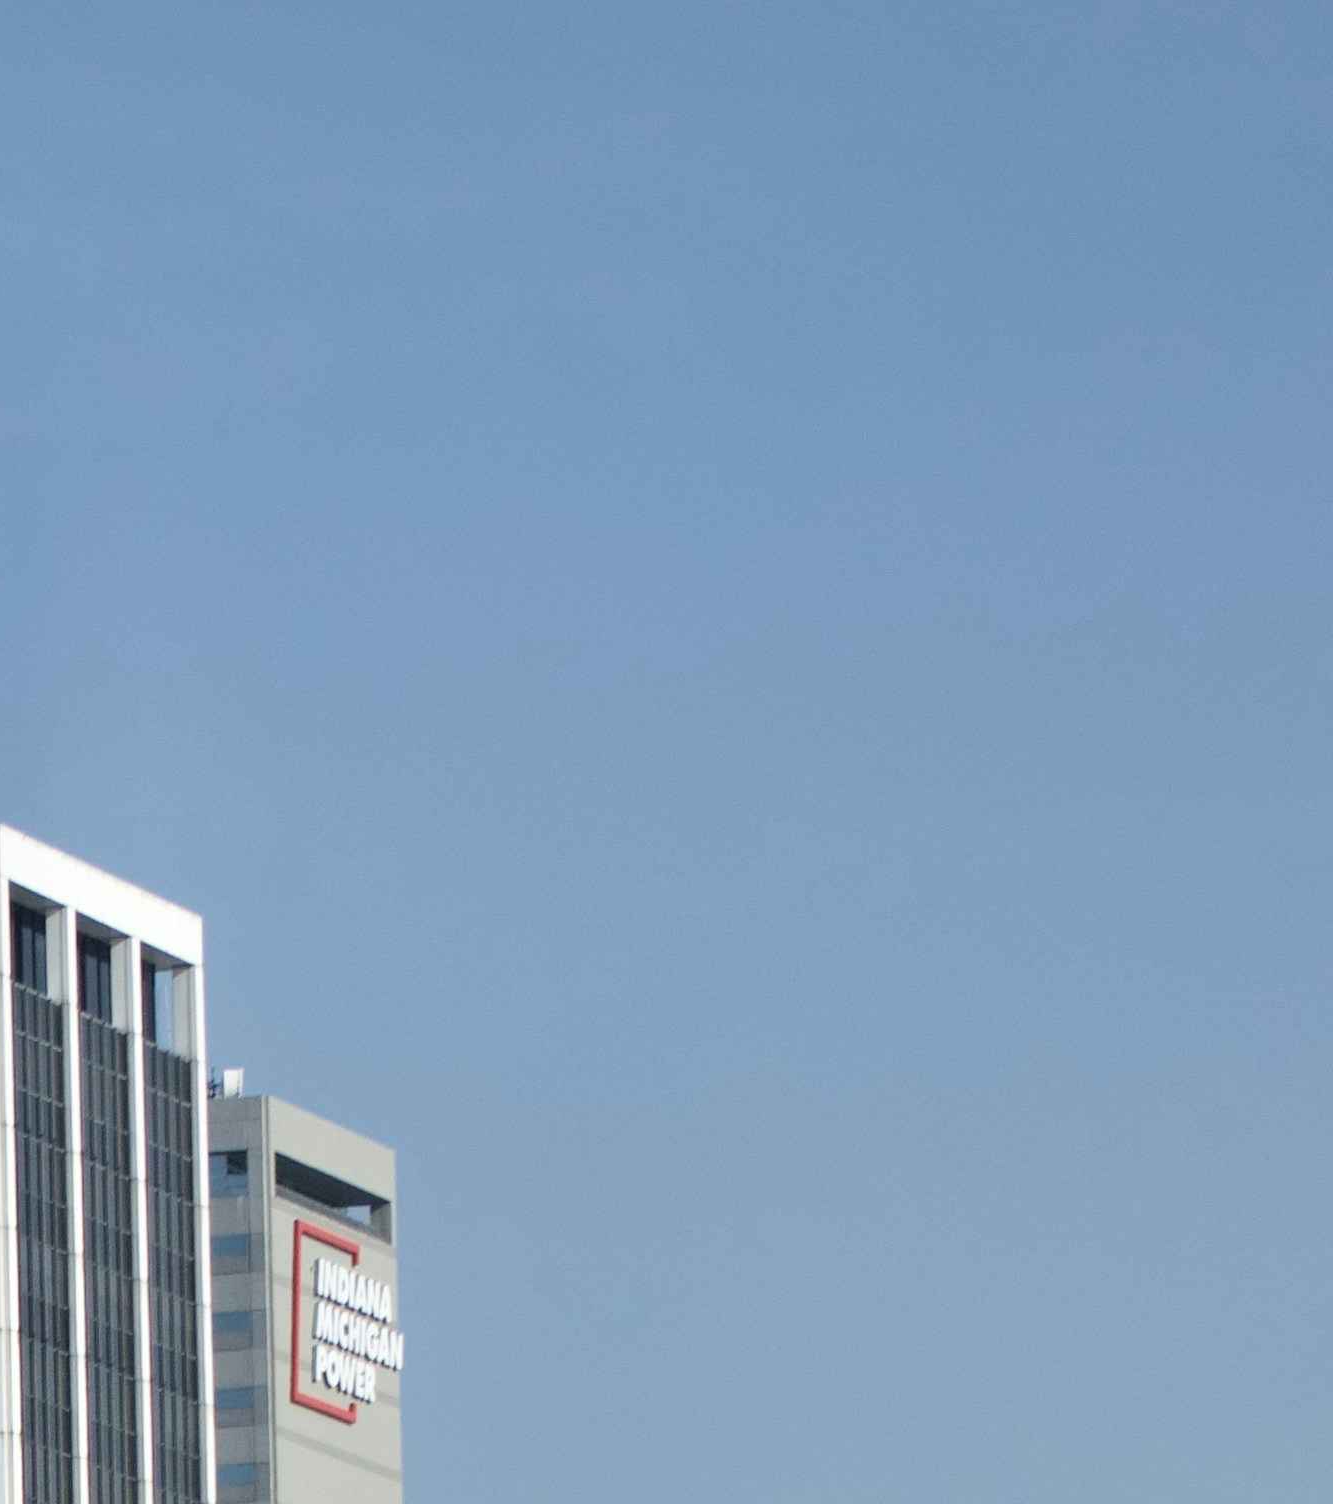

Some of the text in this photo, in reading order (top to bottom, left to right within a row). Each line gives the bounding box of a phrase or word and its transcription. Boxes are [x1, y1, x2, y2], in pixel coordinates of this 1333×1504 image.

[315, 1257, 393, 1324] INDIANA
[313, 1301, 405, 1371] MICHIGAN
[312, 1344, 377, 1404] POWER
